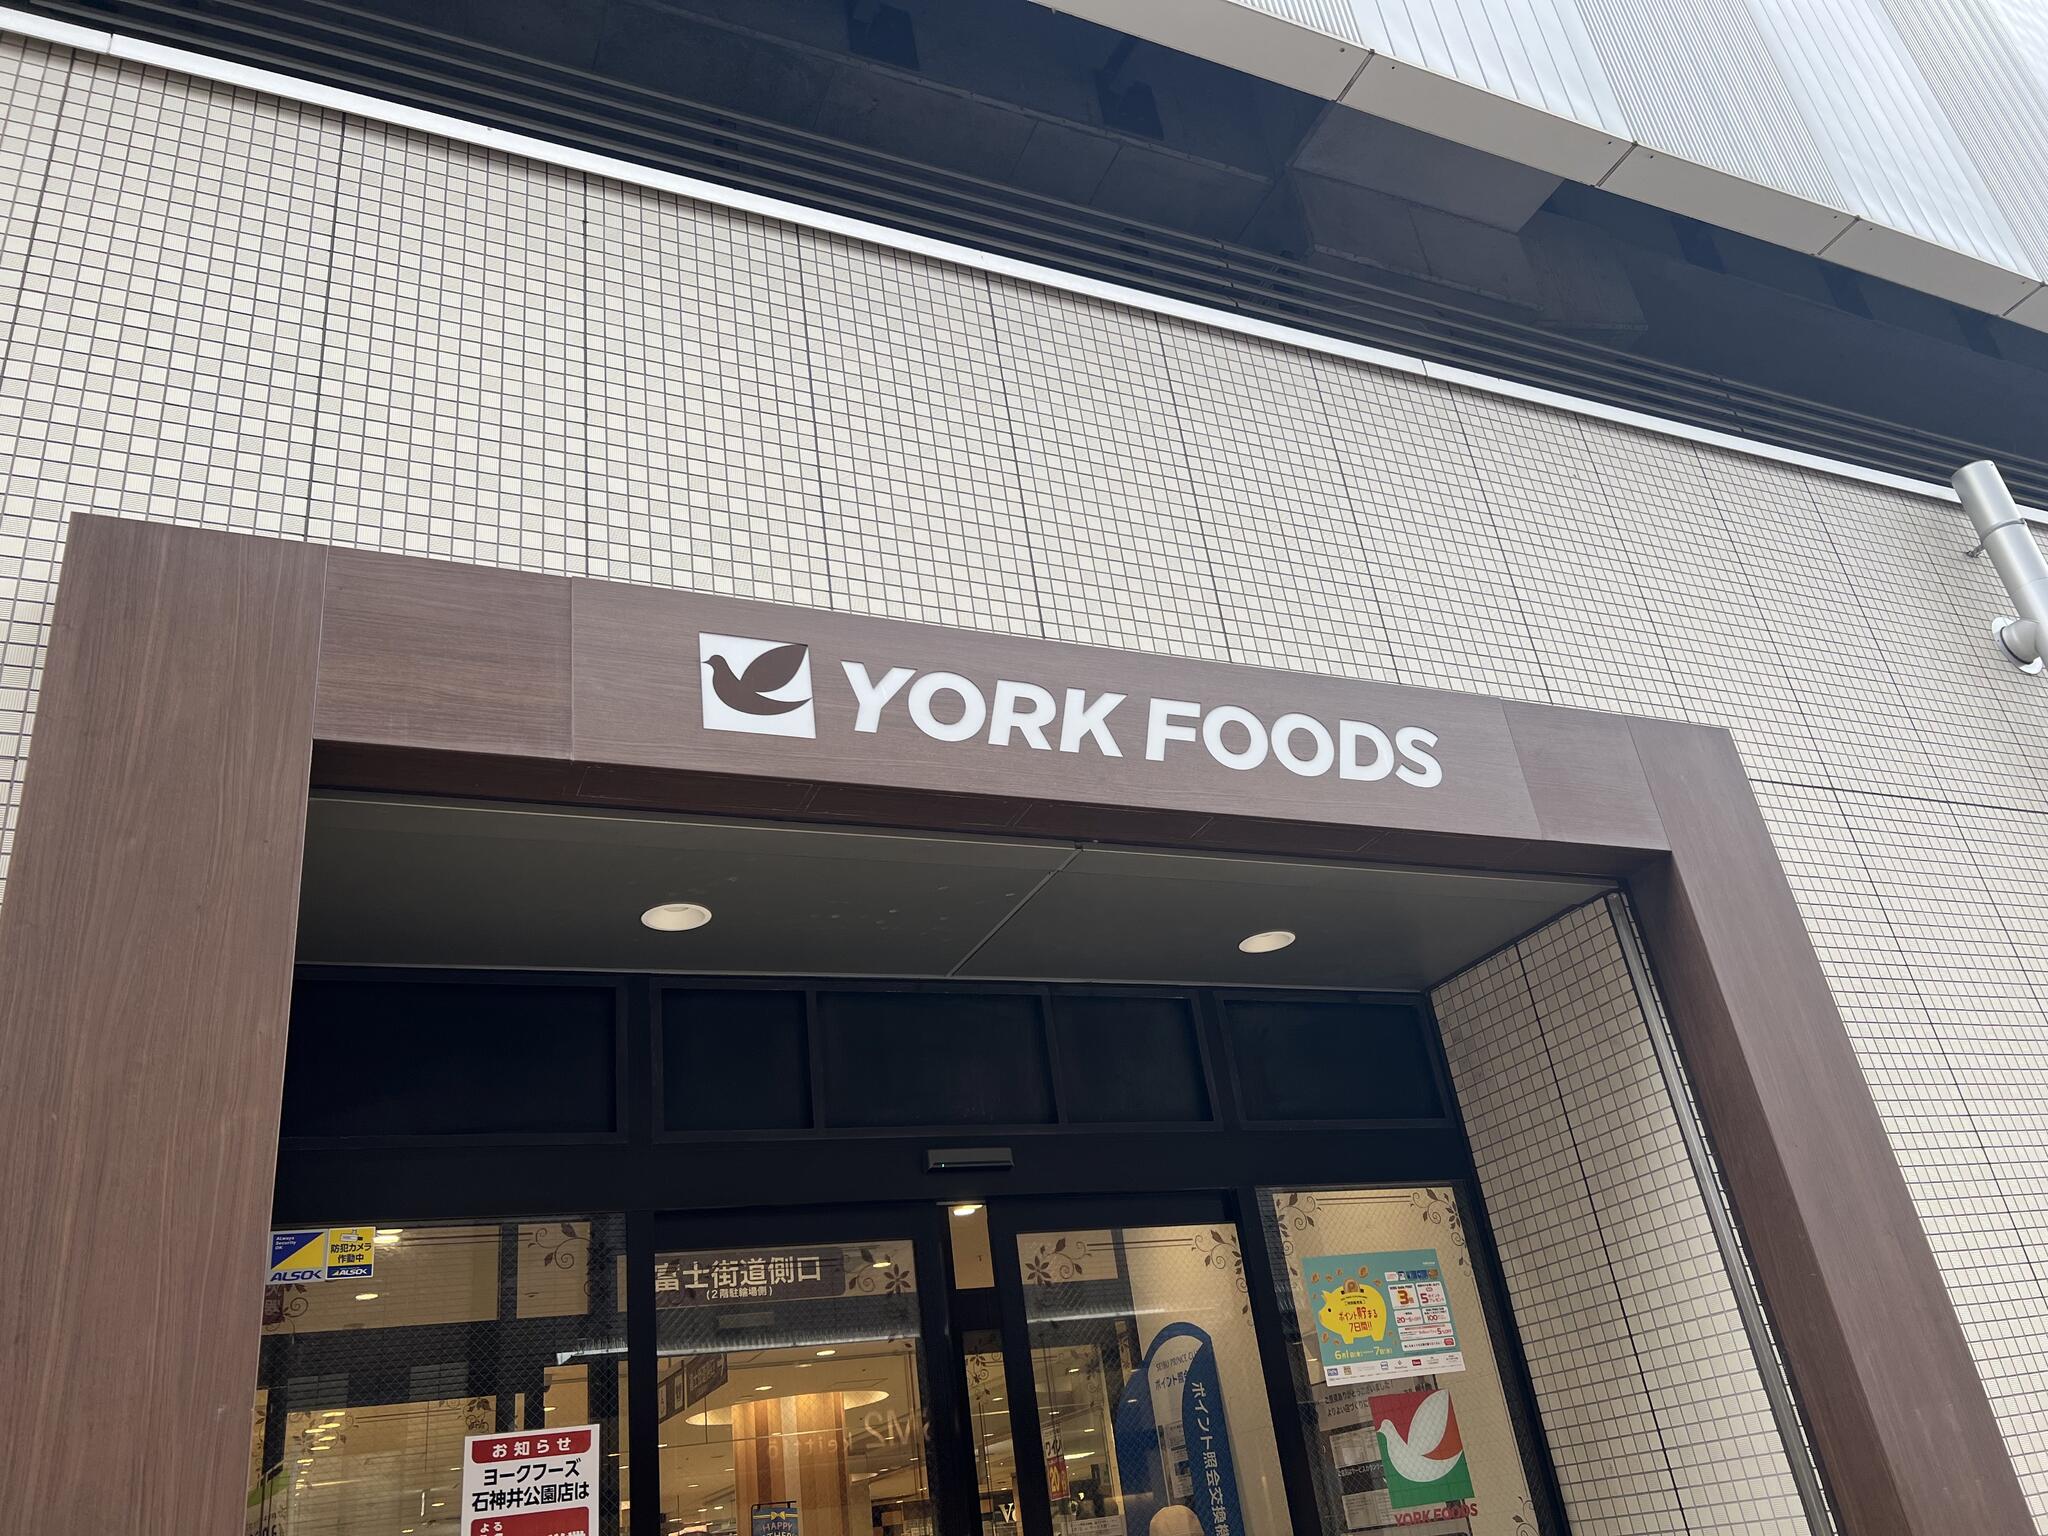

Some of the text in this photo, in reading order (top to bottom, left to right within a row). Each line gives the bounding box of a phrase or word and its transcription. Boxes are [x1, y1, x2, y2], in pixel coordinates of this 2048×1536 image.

[840, 660, 1443, 789] YORK FOODS
[331, 1243, 372, 1254] 防犯カメラ
[338, 1254, 364, 1264] 作動中
[270, 1270, 322, 1282] ALSOK
[492, 1438, 572, 1458] お知らせ
[484, 1458, 582, 1486] ヨークフーズ
[472, 1481, 590, 1512] 石神井公園店は
[1394, 1508, 1433, 1527] YORK
[1433, 1503, 1478, 1520] FOODS
[480, 1521, 503, 1534] よる
[762, 1521, 793, 1532] HAPPY
